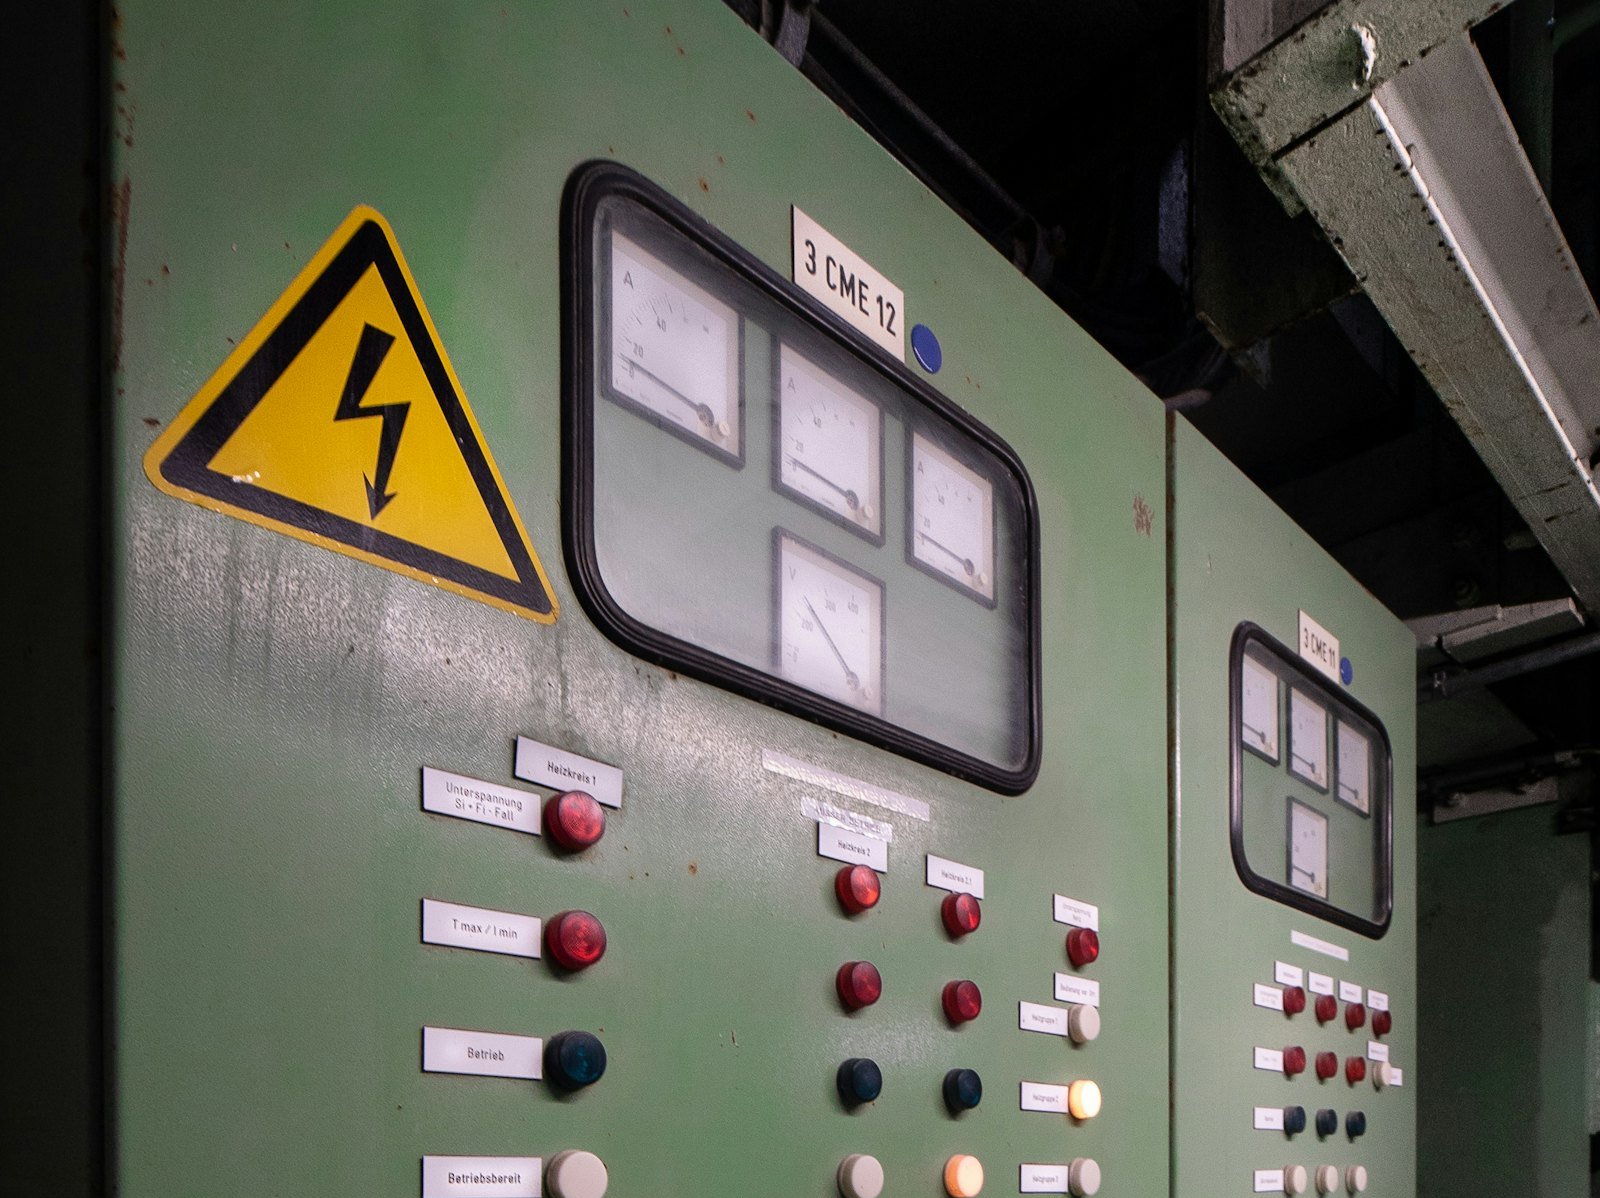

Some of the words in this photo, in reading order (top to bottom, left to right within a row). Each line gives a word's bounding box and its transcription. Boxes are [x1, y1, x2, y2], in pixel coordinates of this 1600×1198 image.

[622, 270, 634, 290] A
[804, 238, 817, 276] 3
[826, 255, 870, 317] CME
[876, 294, 896, 338] 12
[787, 376, 796, 393] A
[1304, 627, 1309, 649] 3
[1311, 633, 1327, 663] CME
[1328, 647, 1336, 670] 11
[547, 760, 591, 784] Heizkreis
[591, 774, 597, 786] 1
[446, 780, 523, 812] Unterspannung
[454, 797, 466, 812] Si
[475, 802, 486, 815] Fi
[494, 807, 514, 822] Fall
[452, 918, 458, 930] T
[460, 922, 482, 934] max
[499, 927, 518, 940] min
[467, 1046, 505, 1062] Betrieb
[448, 1171, 522, 1185] Betriebsbereit
